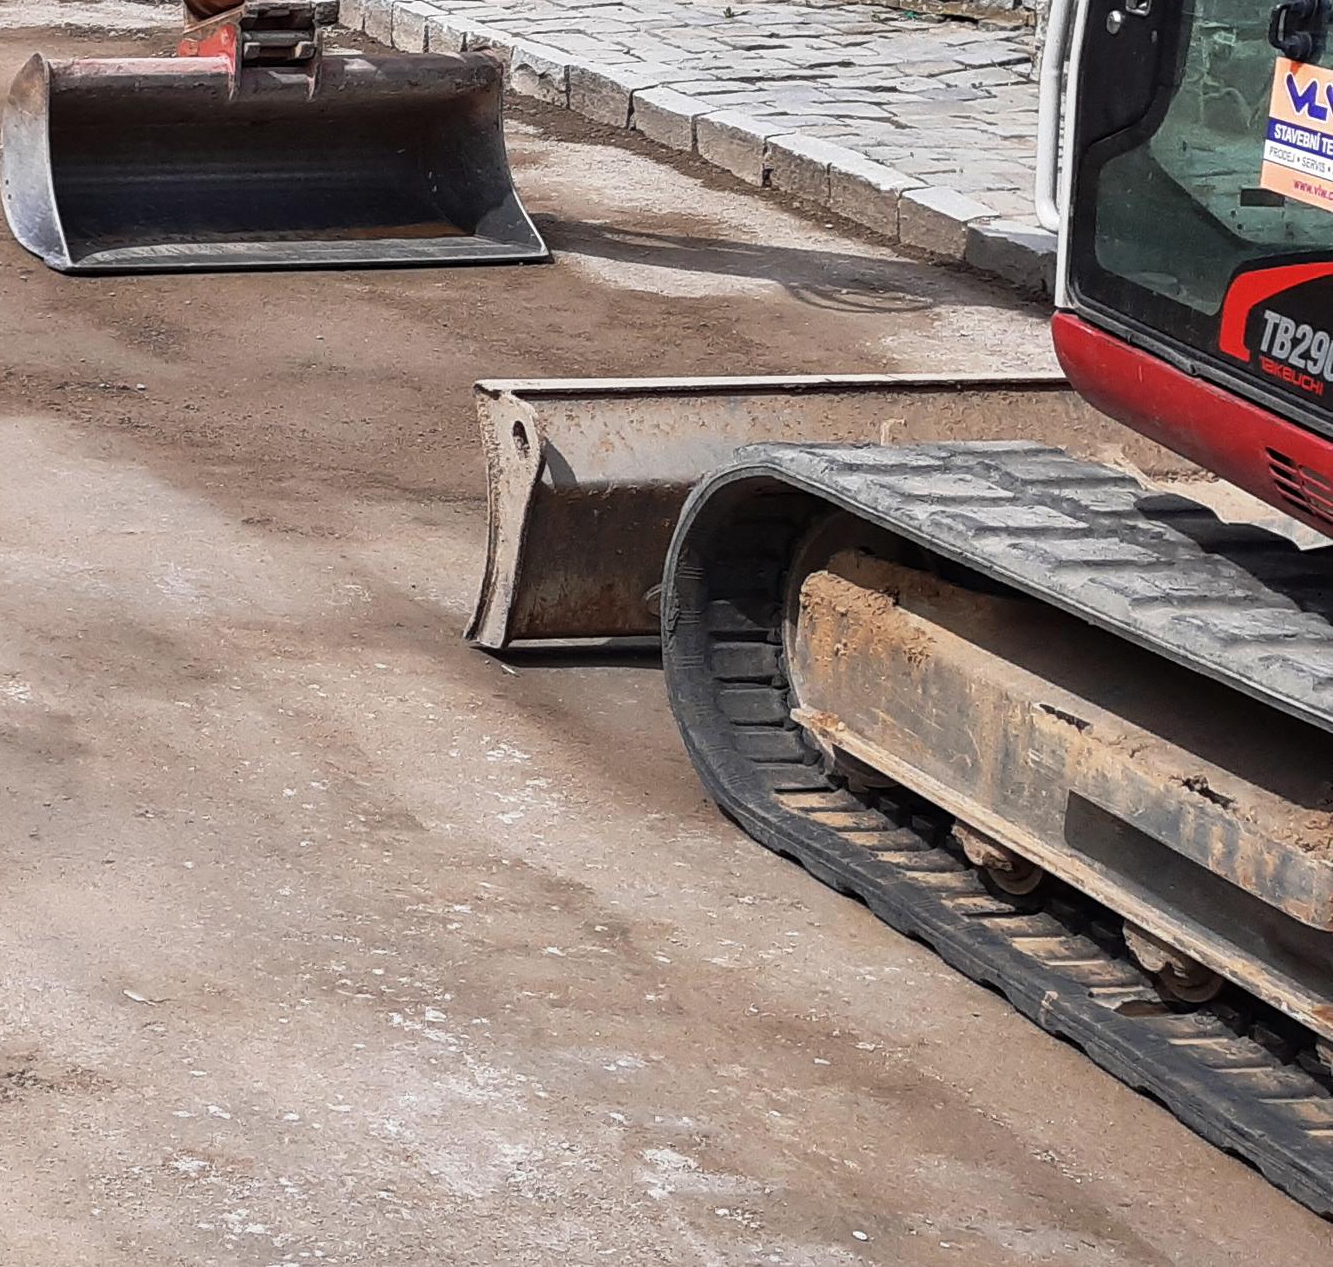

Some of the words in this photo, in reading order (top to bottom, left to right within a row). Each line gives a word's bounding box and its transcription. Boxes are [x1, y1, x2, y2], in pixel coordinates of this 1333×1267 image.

[1286, 73, 1333, 121] VL
[1274, 123, 1321, 151] STAVEBNÍ
[1269, 145, 1296, 164] PRODEJ
[1302, 156, 1326, 174] SERVIS
